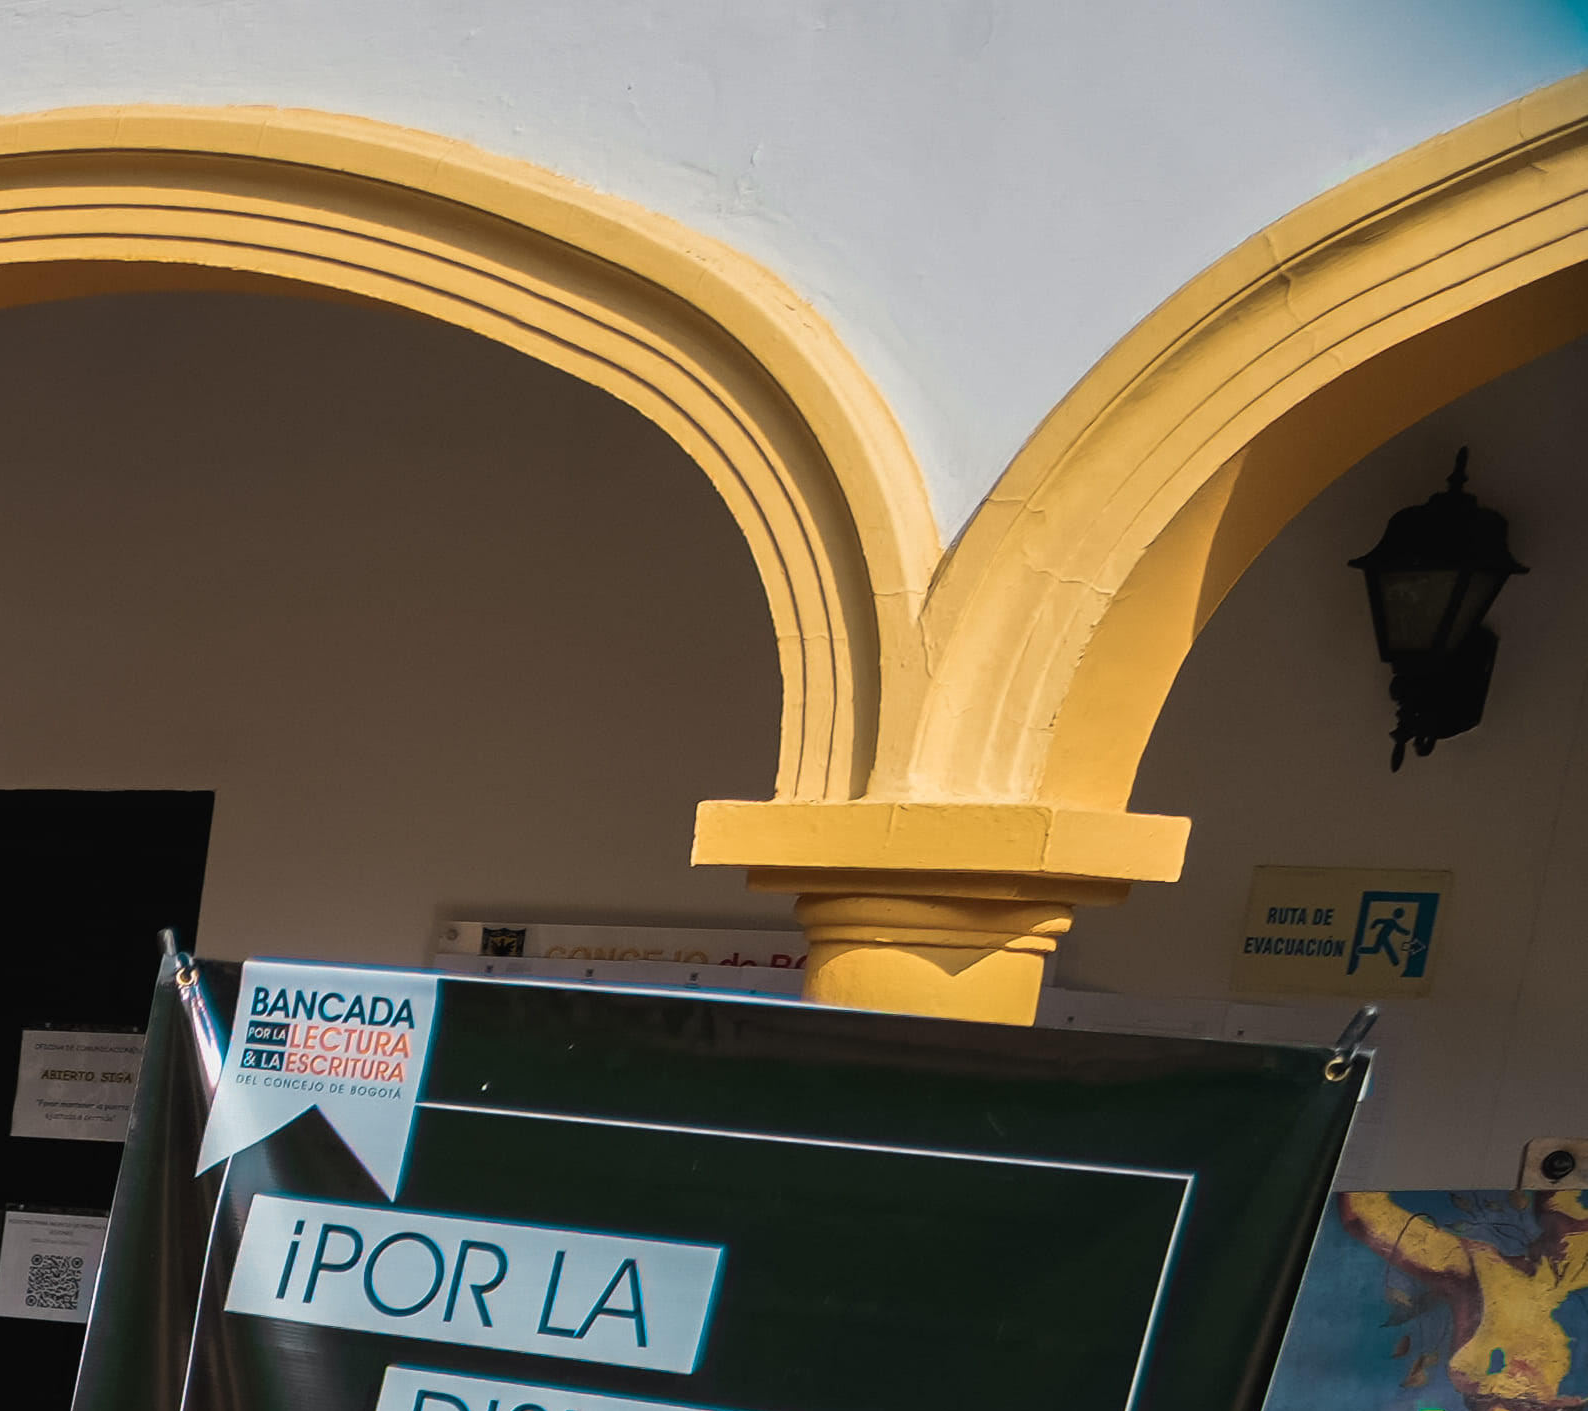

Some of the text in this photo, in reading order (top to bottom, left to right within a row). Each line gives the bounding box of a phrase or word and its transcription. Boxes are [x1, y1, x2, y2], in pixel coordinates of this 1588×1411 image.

[1266, 906, 1334, 927] RUTA DE
[1242, 933, 1346, 958] EVACUACIÓN
[250, 986, 415, 1029] BANCADA
[247, 1024, 411, 1058] POR LA LECTURA
[243, 1052, 405, 1083] & LA ESCRITURA
[236, 1074, 402, 1100] DEL CONCEJO DE BOGOTÁ
[535, 1250, 650, 1348] LA
